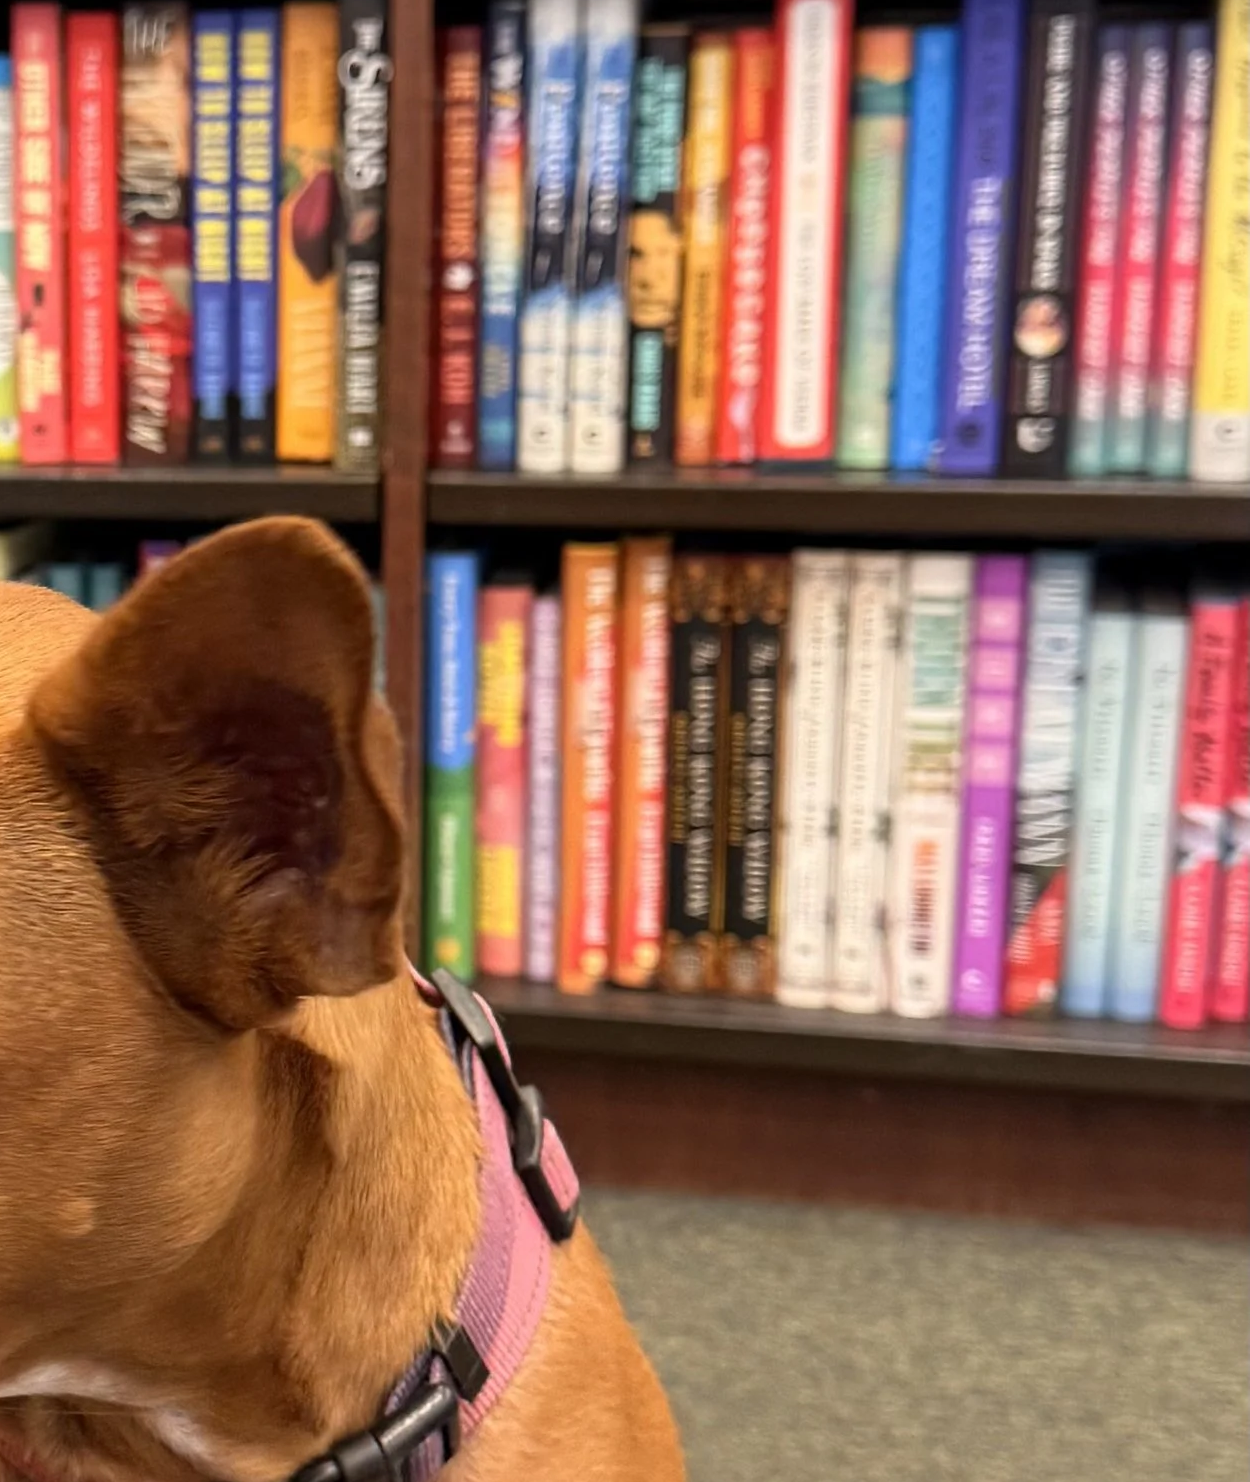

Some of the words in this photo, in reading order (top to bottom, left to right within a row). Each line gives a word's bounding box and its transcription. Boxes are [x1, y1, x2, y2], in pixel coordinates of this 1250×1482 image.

[82, 48, 103, 91] THE
[198, 31, 230, 83] HOW
[241, 30, 272, 81] HOW
[445, 51, 477, 100] THE
[18, 60, 51, 131] OTHER
[198, 88, 230, 117] TO
[239, 86, 272, 116] TO
[337, 50, 394, 191] SIRENS
[21, 136, 51, 184] SIDE
[198, 120, 230, 183] SLEEP
[239, 119, 272, 182] SLEEP
[443, 104, 476, 259] LIBERATORS
[21, 190, 52, 215] OF
[197, 187, 230, 214] AT
[239, 185, 272, 213] AT
[971, 177, 1002, 225] THE
[21, 220, 52, 272] NOW
[198, 219, 230, 284] NIGHT
[238, 217, 272, 283] NIGHT
[731, 144, 769, 386] CHEESECAKE
[346, 261, 381, 348] EMILIA
[961, 229, 998, 328] DREAM
[346, 353, 378, 415] HART
[445, 352, 472, 405] KOH
[955, 333, 993, 412] HOTEL
[692, 641, 721, 673] The
[750, 641, 779, 673] The
[1193, 654, 1222, 724] Family
[687, 755, 714, 827] KONG
[744, 756, 772, 830] KONG
[686, 828, 711, 920] WIDOW
[742, 831, 770, 924] WIDOW
